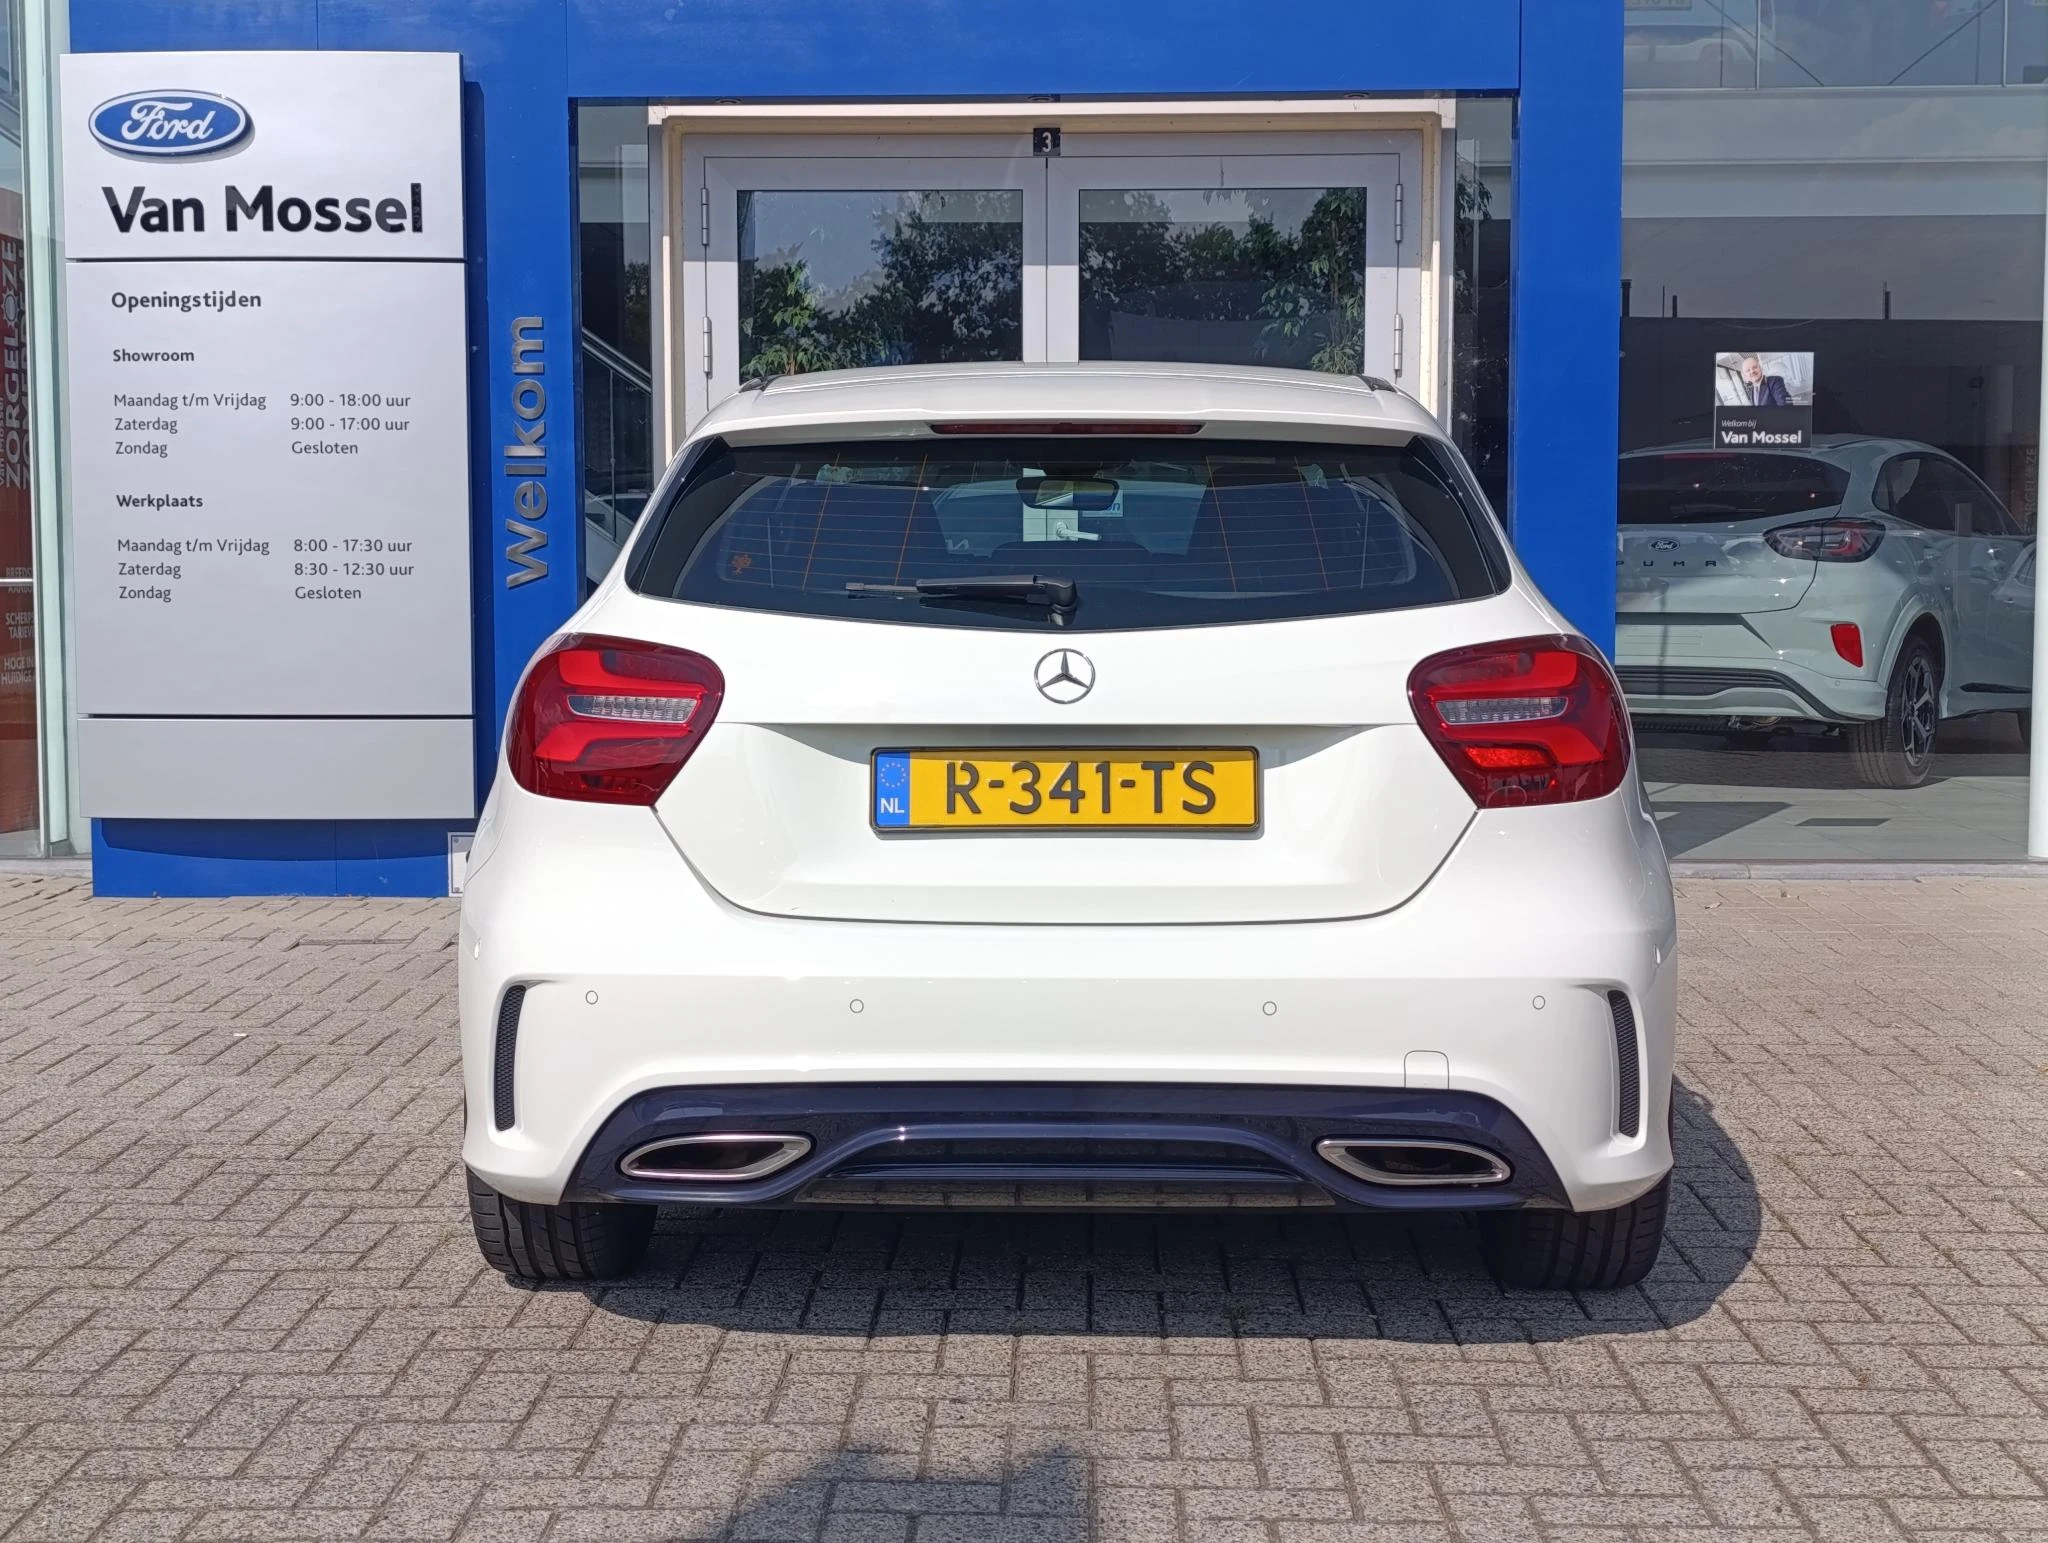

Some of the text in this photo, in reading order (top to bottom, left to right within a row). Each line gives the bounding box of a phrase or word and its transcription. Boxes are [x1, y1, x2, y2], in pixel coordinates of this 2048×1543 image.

[120, 100, 217, 141] Ford
[1042, 131, 1052, 153] 3
[102, 182, 424, 234] Van Mossel
[111, 289, 262, 313] Openingstijden
[112, 347, 195, 363] Showroom
[113, 392, 267, 411] Maandag t/m Vrijdag
[290, 393, 324, 407] 9:00
[339, 393, 382, 407] 18:00
[385, 397, 412, 407] uur
[114, 416, 178, 434] Zaterdag
[290, 417, 325, 431] 9:00
[339, 417, 381, 431] 17:00
[384, 420, 410, 431] uur
[1721, 420, 1747, 428] Welkom
[1721, 430, 1802, 444] Van Mossel
[115, 440, 168, 458] Zondag
[291, 440, 359, 455] Gesloten
[504, 315, 548, 590] Welkom
[115, 493, 204, 511] Werkplaats
[117, 538, 271, 556] Maandag t/m Vrijdag
[293, 538, 328, 552] 8:00
[342, 538, 384, 553] 17:30
[387, 542, 413, 553] uur
[118, 561, 182, 580] Zaterdag
[294, 562, 328, 576] 8:30
[343, 562, 385, 576] 12:30
[389, 565, 415, 576] uur
[118, 585, 172, 603] Zondag
[294, 585, 362, 600] Gesloten
[946, 760, 1217, 815] R-341-TS
[880, 798, 905, 814] NL
